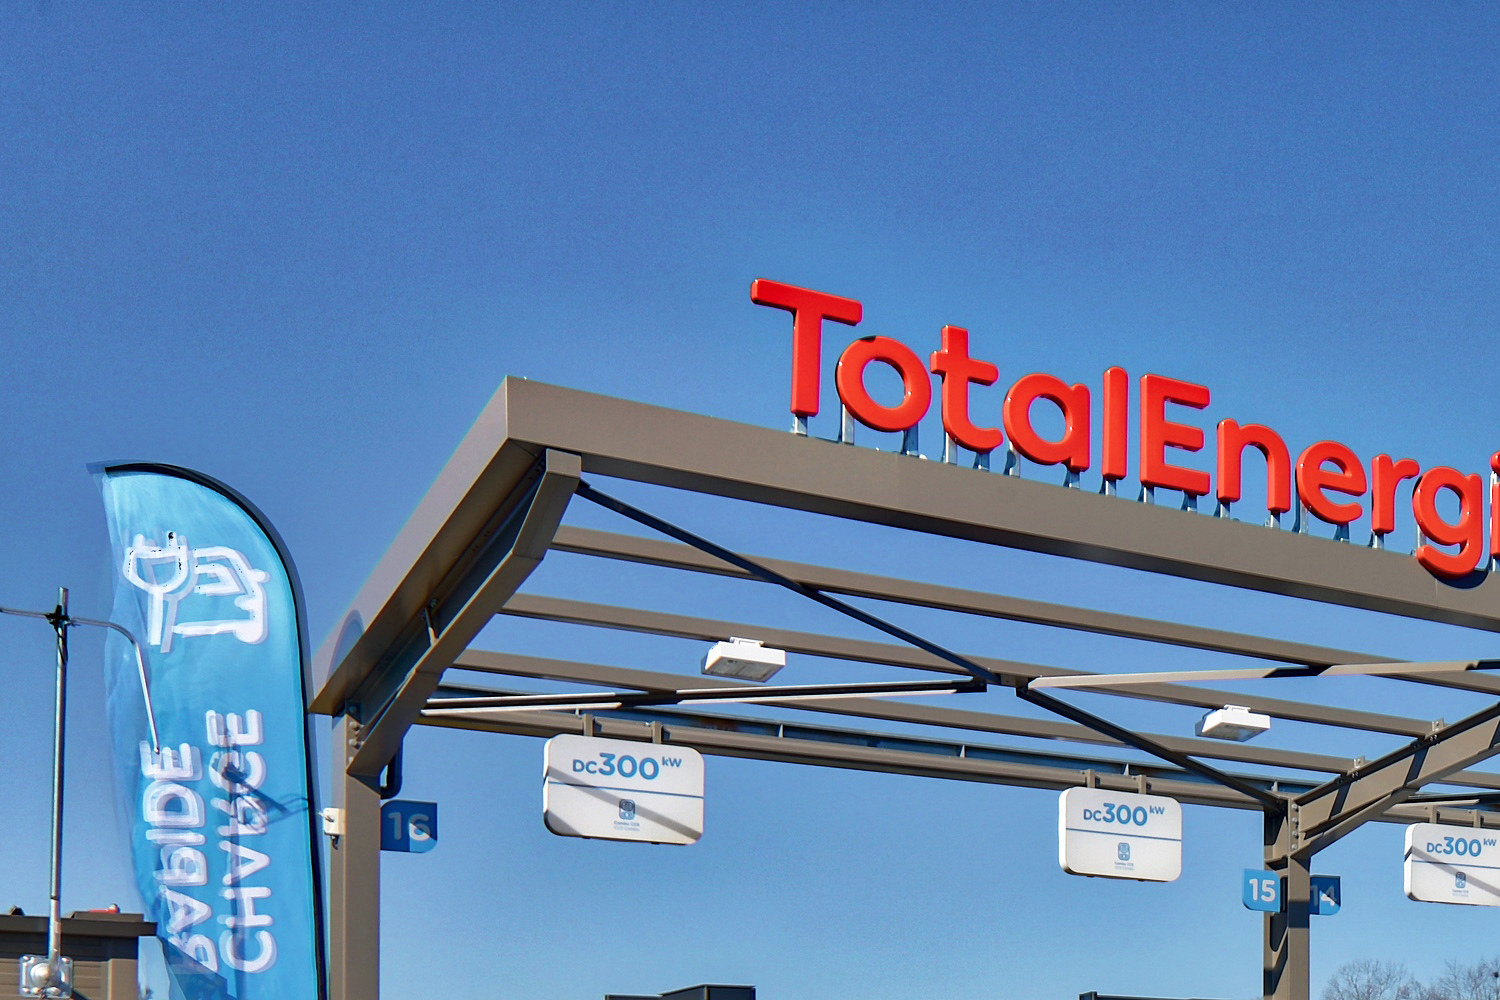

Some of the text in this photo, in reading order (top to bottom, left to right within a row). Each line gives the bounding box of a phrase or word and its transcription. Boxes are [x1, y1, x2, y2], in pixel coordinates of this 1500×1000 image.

[388, 812, 431, 842] 16
[1249, 878, 1276, 902] 15
[1311, 884, 1336, 906] 14
